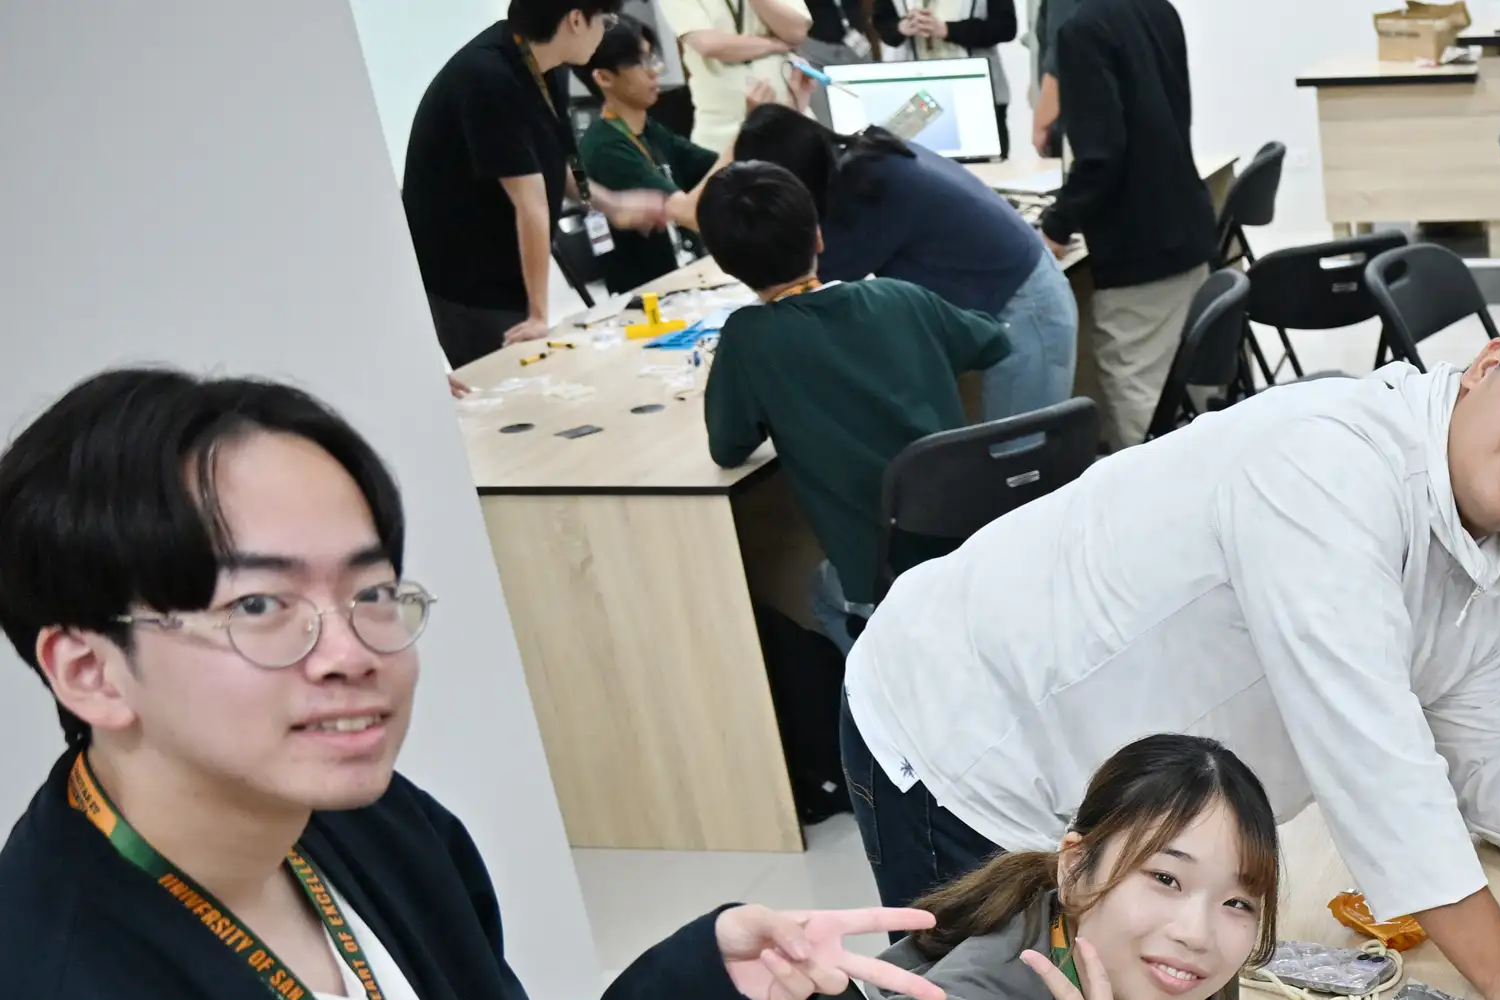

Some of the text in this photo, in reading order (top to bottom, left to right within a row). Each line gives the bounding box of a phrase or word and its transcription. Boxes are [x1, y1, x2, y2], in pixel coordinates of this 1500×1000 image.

[158, 873, 254, 952] UNIVERSITY
[248, 949, 275, 972] OF
[338, 931, 358, 953] OF
